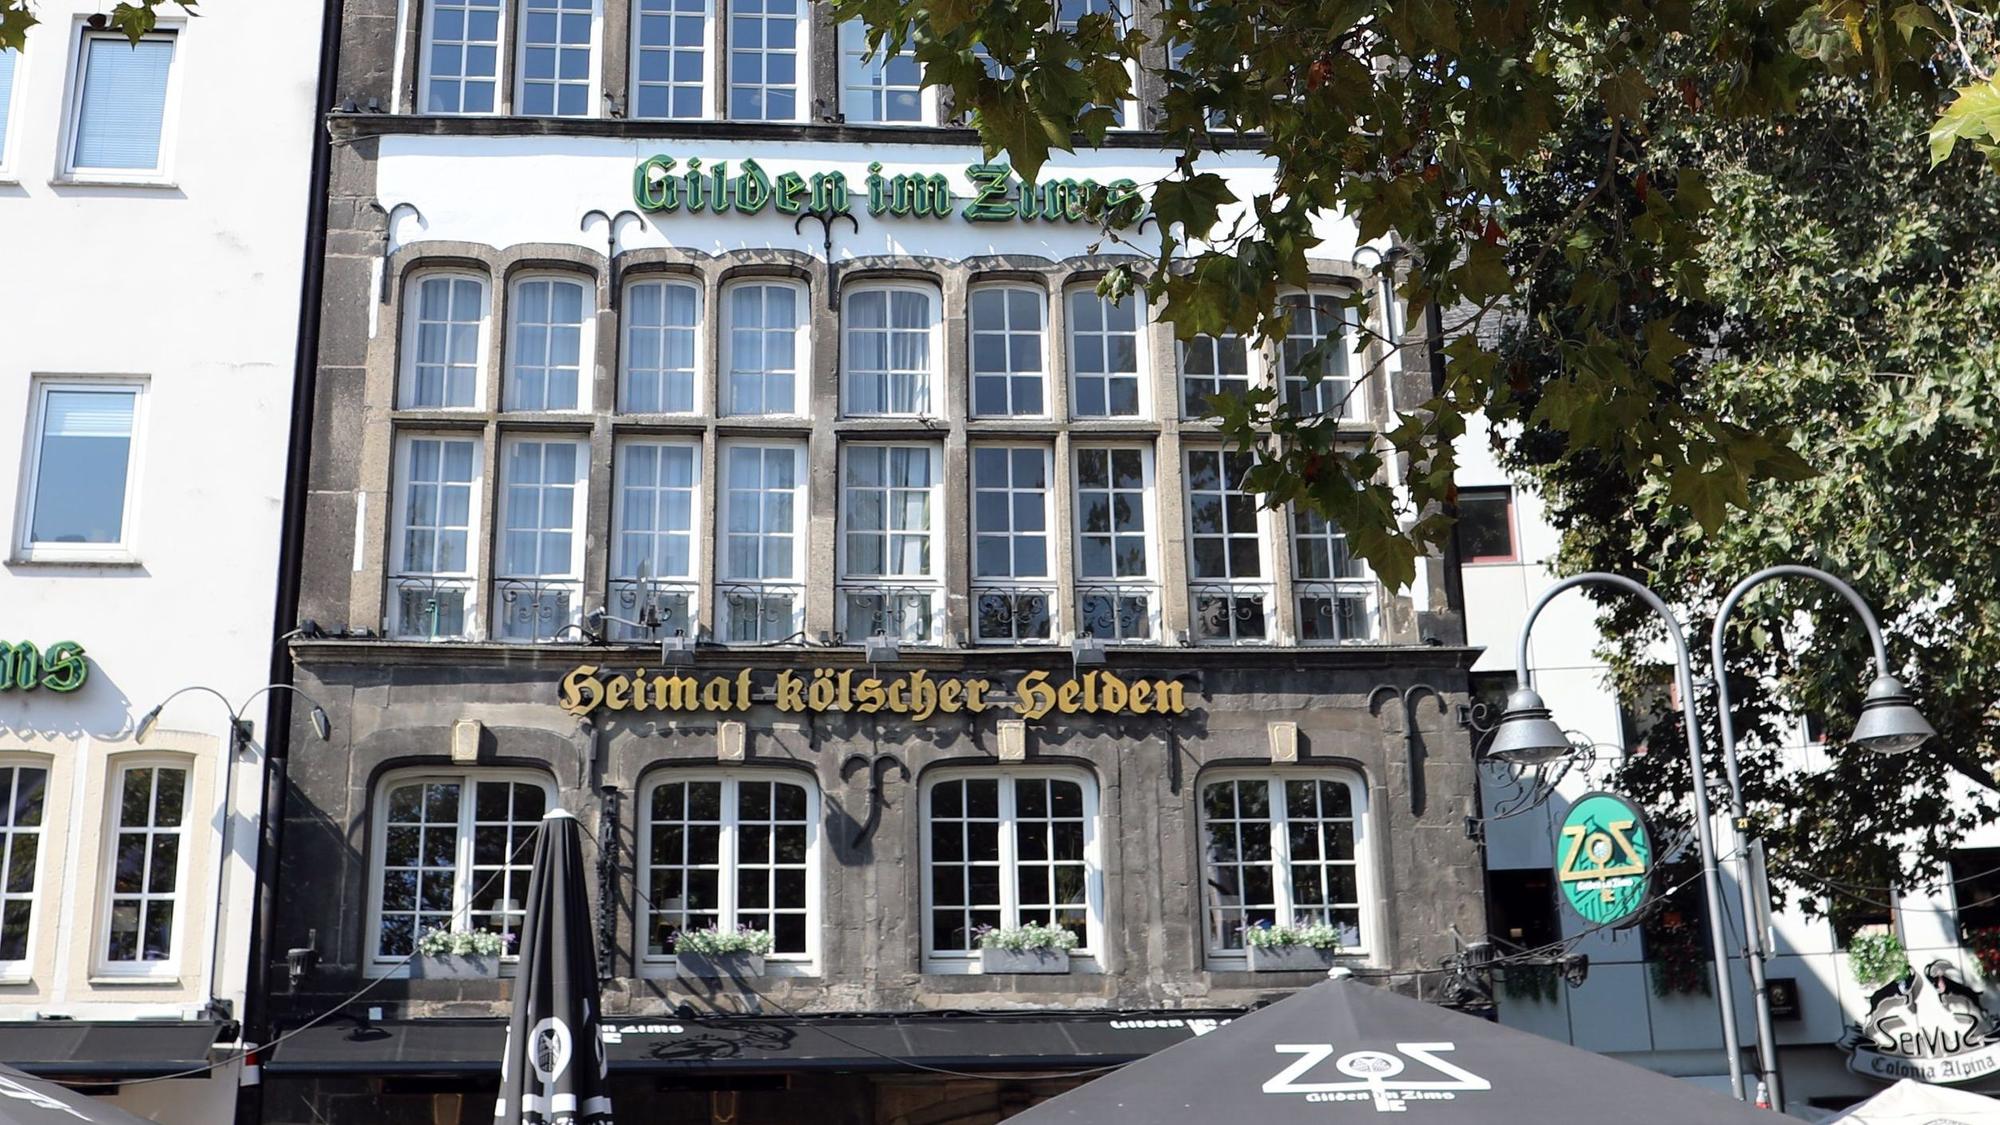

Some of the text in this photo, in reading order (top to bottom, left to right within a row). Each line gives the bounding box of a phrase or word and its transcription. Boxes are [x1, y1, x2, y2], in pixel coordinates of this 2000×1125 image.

[633, 154, 851, 216] Gilden
[864, 161, 953, 219] im
[559, 664, 1185, 721] Heimat kölscher Helden
[1871, 1055, 1997, 1079] Colonia Alpina
[1305, 1092, 1370, 1102] Gilden
